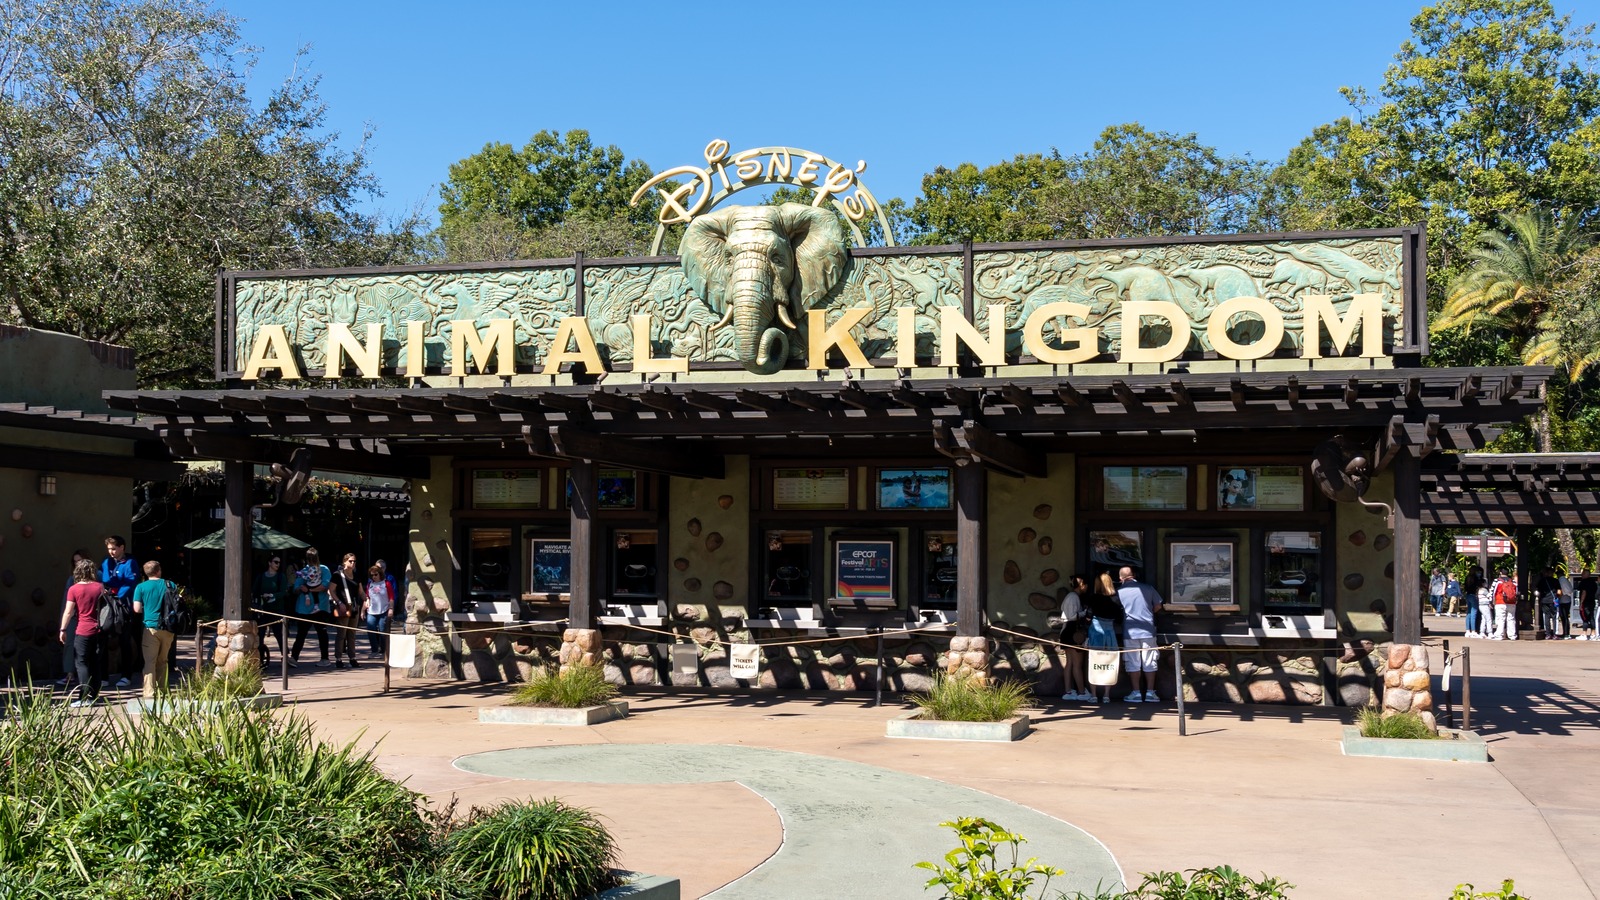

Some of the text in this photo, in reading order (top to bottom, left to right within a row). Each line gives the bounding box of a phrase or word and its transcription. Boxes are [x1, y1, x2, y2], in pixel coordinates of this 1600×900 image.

[241, 293, 1387, 380] ANIMAL KINGDOM
[852, 550, 877, 558] EPCOT
[864, 558, 888, 568] ARTS
[1093, 663, 1115, 671] ENTER
